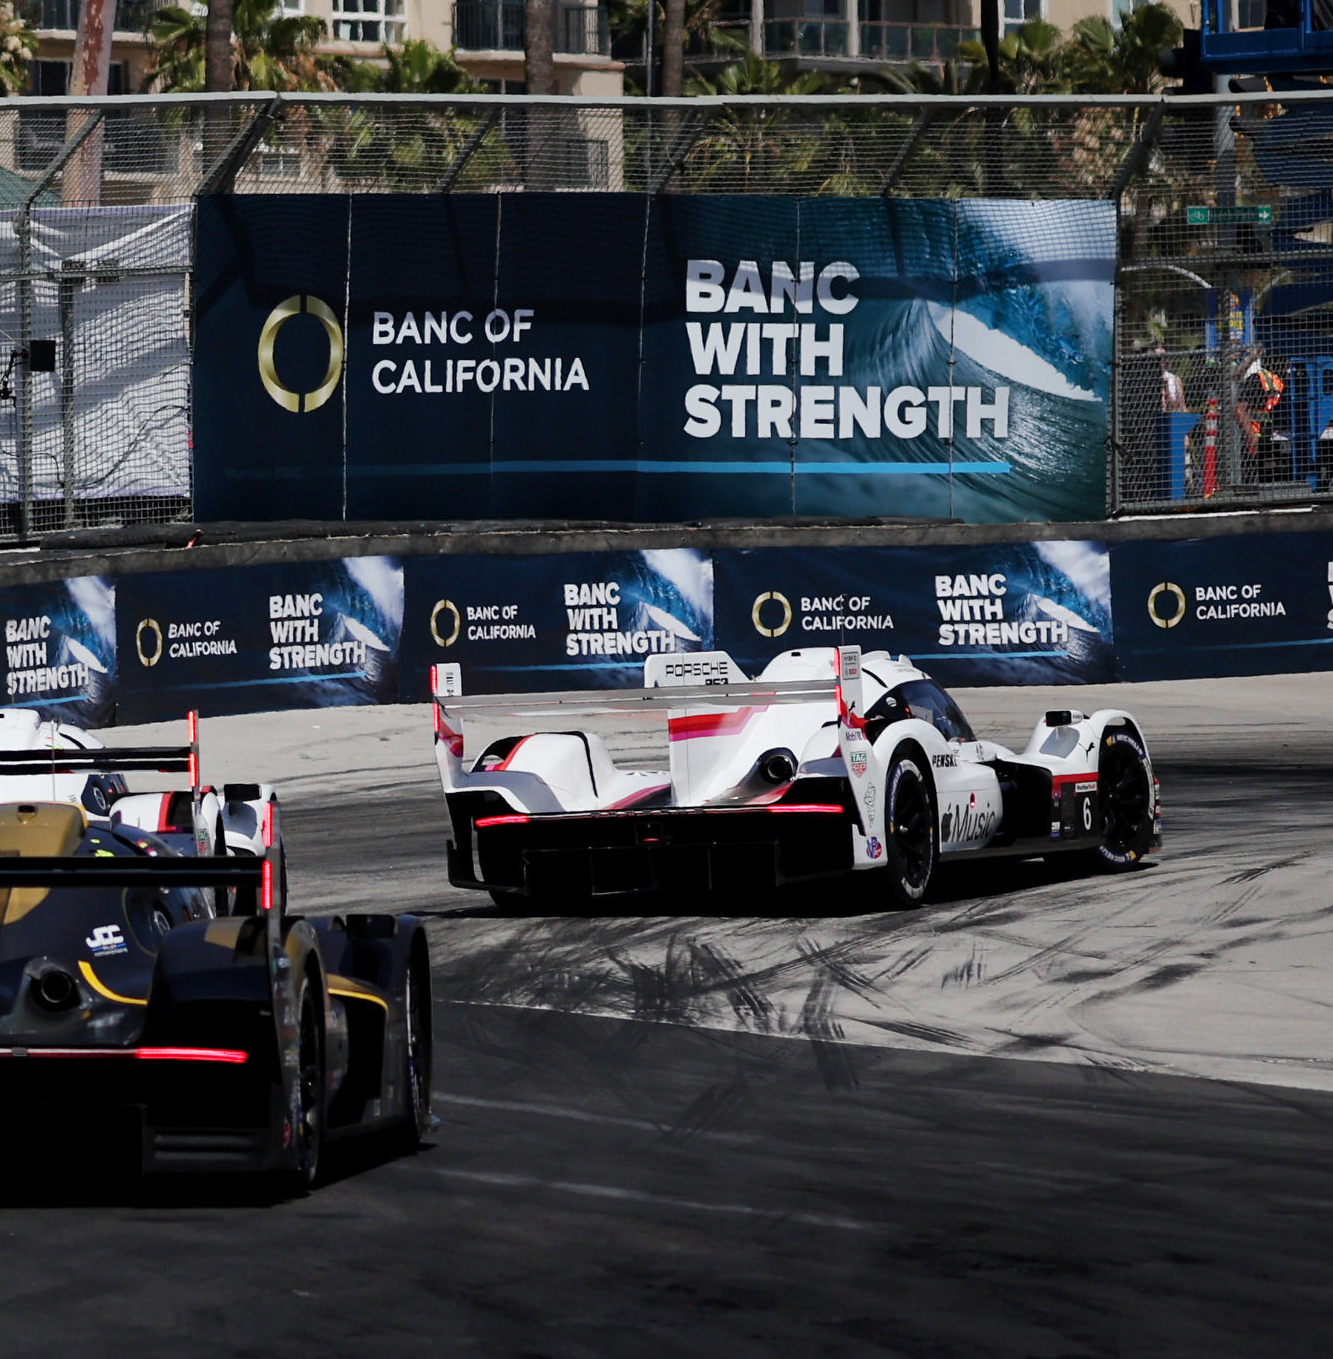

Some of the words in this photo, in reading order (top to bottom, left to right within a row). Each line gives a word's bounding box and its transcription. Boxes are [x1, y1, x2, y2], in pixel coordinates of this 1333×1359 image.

[686, 259, 861, 315] BANC
[372, 309, 473, 344] BANC
[484, 308, 534, 343] OF
[686, 321, 844, 376] WITH
[372, 357, 590, 393] CALIFORNIA
[683, 384, 1009, 440] STRENGTH
[564, 582, 621, 606] BANC
[935, 574, 1007, 597] BANC
[1196, 586, 1237, 601] BANC
[1241, 584, 1261, 599] OF
[269, 593, 324, 619] BANC
[467, 605, 500, 621] BANC
[503, 605, 518, 620] OF
[801, 595, 843, 612] BANC
[849, 596, 870, 611] OF
[937, 599, 1003, 621] WITH
[1196, 602, 1286, 620] CALIFORNIA
[5, 615, 52, 643] BANC
[168, 623, 202, 639] BANC
[204, 621, 221, 636] OF
[270, 619, 319, 644] WITH
[567, 607, 618, 631] WITH
[802, 615, 894, 630] CALIFORNIA
[467, 624, 536, 641] CALIFORNIA
[566, 630, 676, 656] STRENGTH
[938, 621, 1068, 646] STRENGTH
[6, 642, 47, 669] WITH
[169, 640, 238, 659] CALIFORNIA
[269, 641, 366, 671] STRENGTH
[6, 662, 89, 696] STRENGTH
[666, 661, 728, 678] PORSCHE
[952, 802, 995, 842] Music
[1083, 797, 1091, 831] 6
